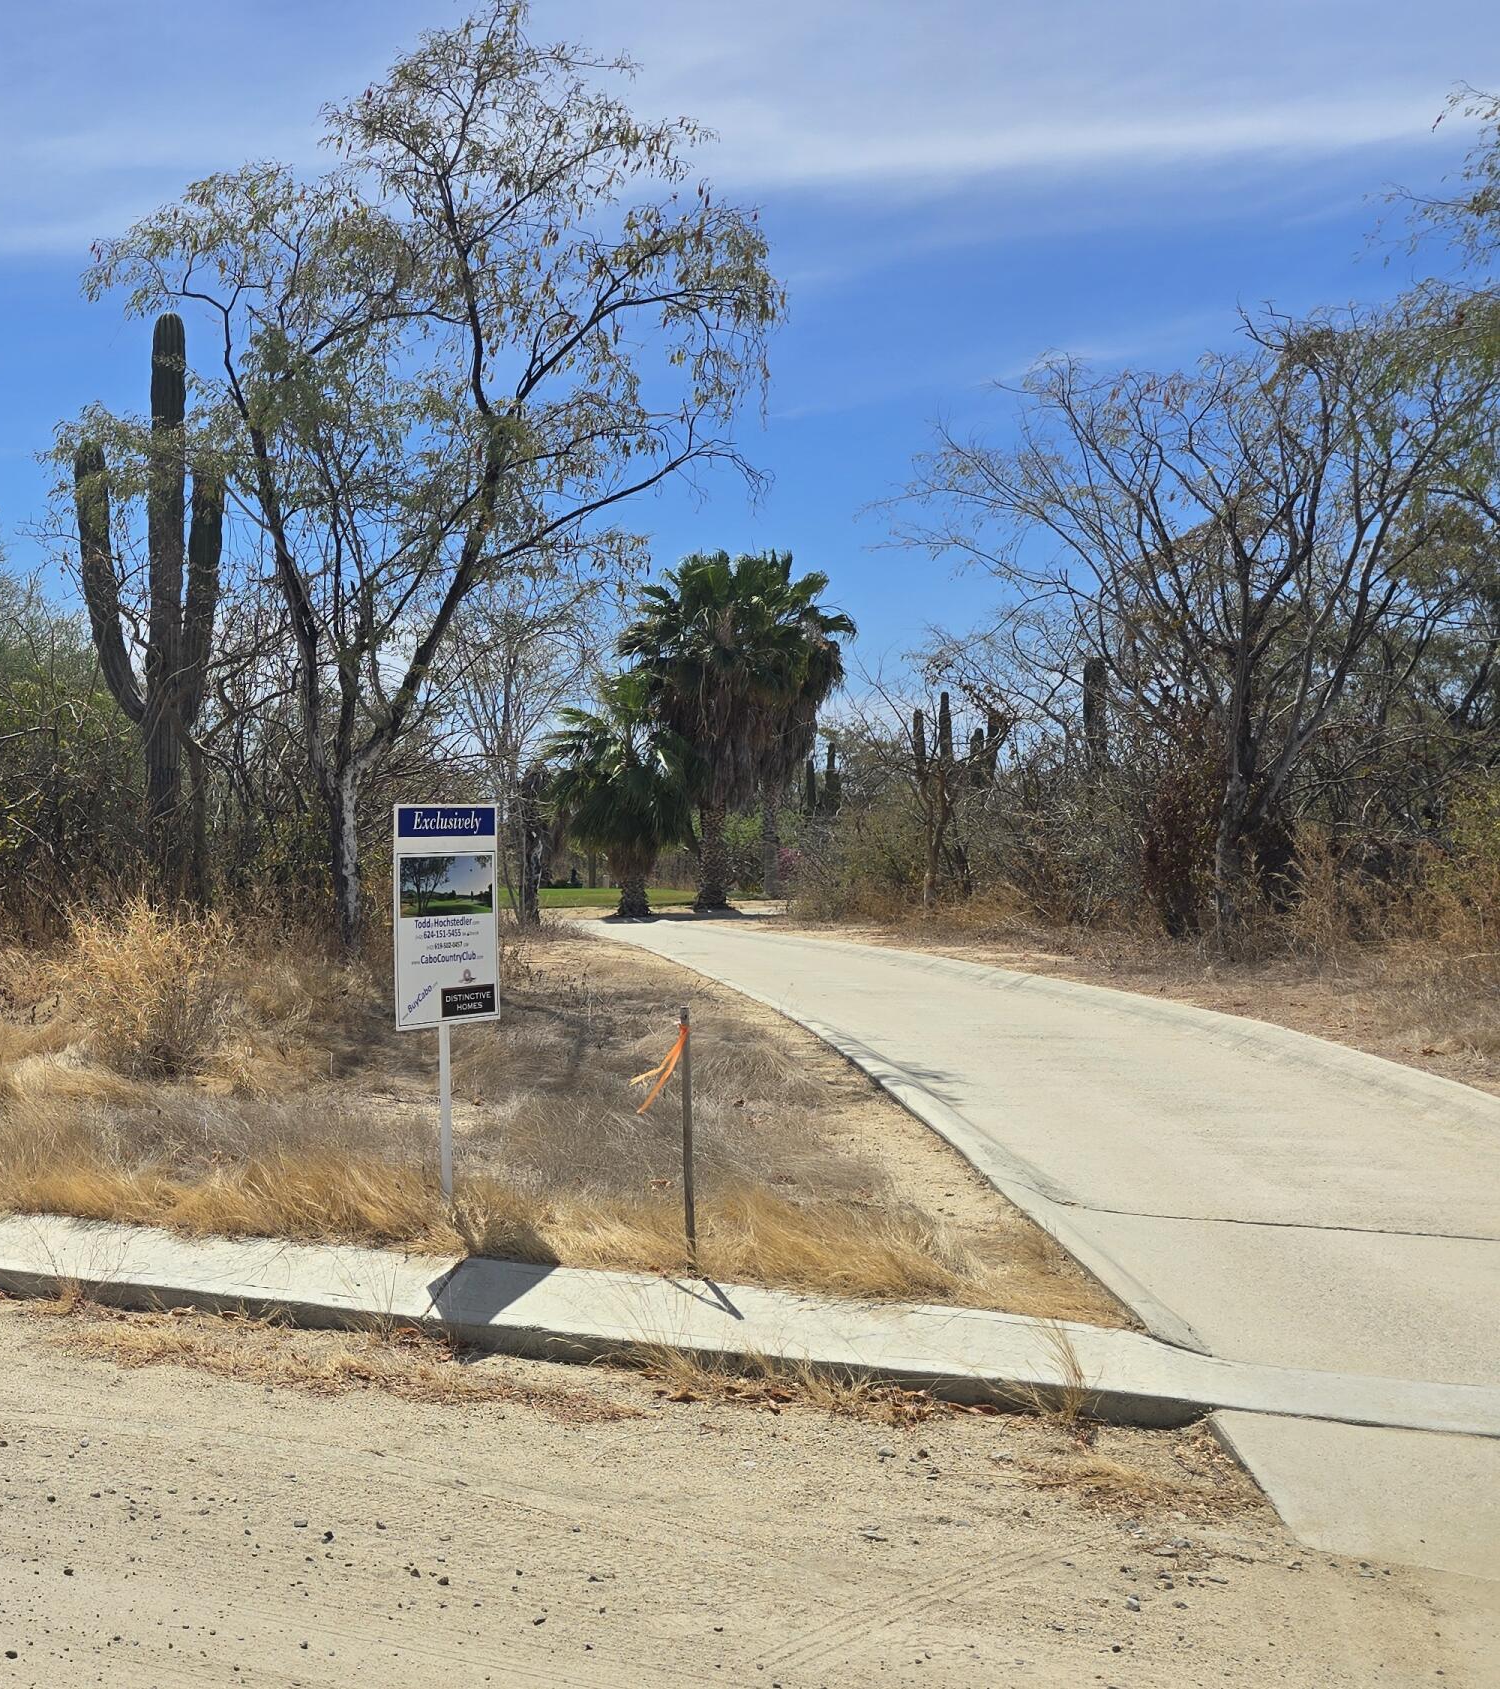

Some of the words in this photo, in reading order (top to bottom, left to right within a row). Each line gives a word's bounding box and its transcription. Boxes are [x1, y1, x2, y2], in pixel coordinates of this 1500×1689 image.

[413, 811, 481, 834] Exclusively
[423, 929, 462, 939] 624-151-5455
[445, 991, 492, 1003] DISTINCTIVE
[456, 1002, 483, 1011] HOMES
